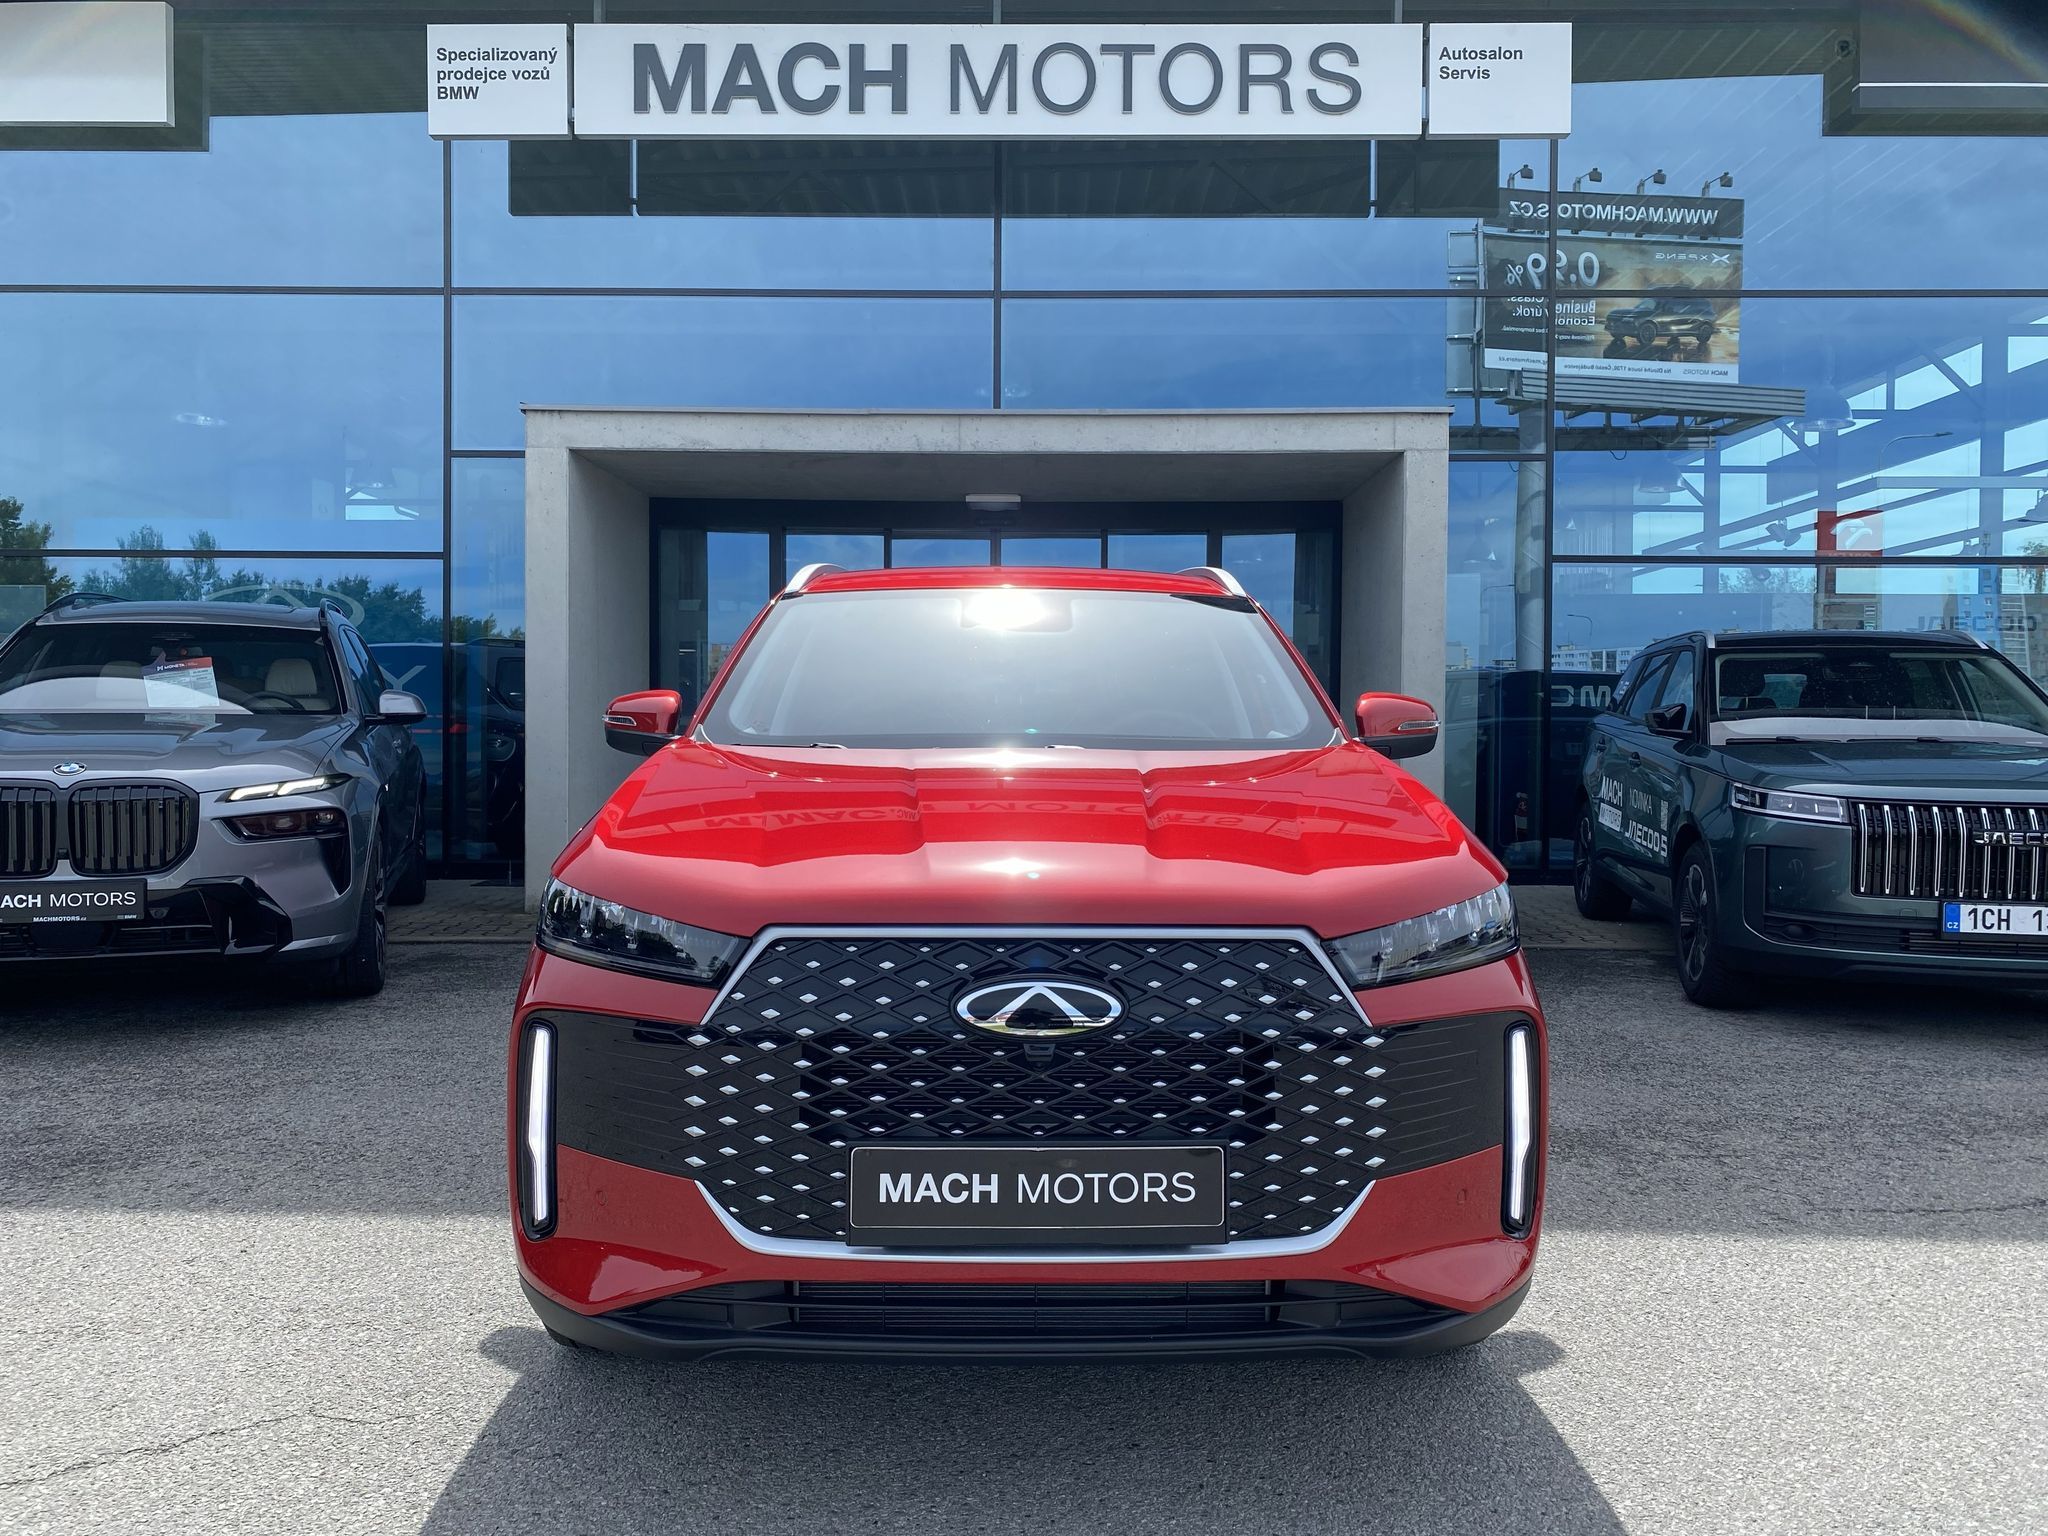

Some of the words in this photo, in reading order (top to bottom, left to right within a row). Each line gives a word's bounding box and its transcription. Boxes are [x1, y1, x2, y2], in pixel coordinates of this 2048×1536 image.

[436, 46, 558, 63] Specializovaný
[1438, 46, 1523, 60] Autosalon
[437, 66, 507, 83] prodejce
[511, 66, 550, 81] vozů
[633, 42, 908, 115] MACH
[950, 42, 1362, 114] MOTORS
[1439, 66, 1491, 79] Servis
[437, 86, 480, 100] BMW
[1601, 776, 1623, 807] MACH
[50, 892, 136, 907] MOTORS
[1968, 908, 2011, 931] 1CH
[878, 1173, 998, 1203] MACH
[1016, 1172, 1196, 1203] MOTORS
